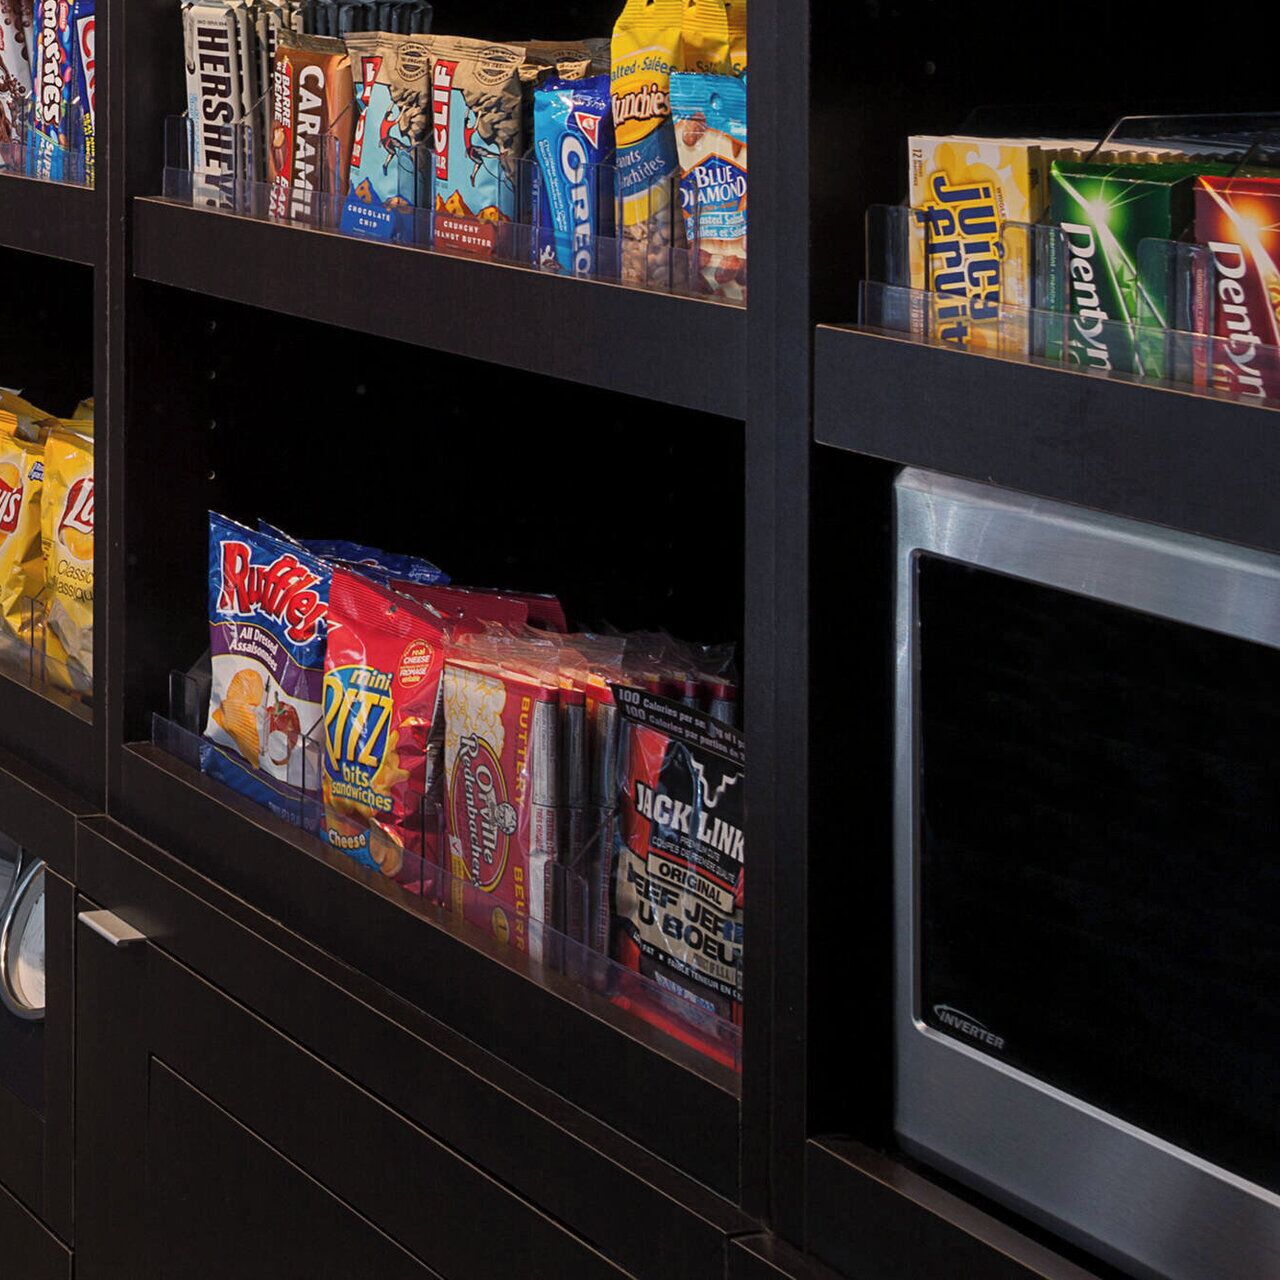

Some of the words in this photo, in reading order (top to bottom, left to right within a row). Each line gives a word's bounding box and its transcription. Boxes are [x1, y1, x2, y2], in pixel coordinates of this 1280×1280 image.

[274, 72, 283, 125] DEMIE
[281, 73, 291, 128] BARRE
[434, 64, 453, 154] CLIF
[695, 165, 734, 189] BLUE
[347, 204, 391, 222] CHOCOLATE
[359, 218, 378, 229] CHIP
[561, 135, 591, 274] OREO
[443, 220, 480, 234] CRUNCHY
[461, 235, 492, 248] BUTTER
[933, 175, 1005, 321] juicy
[915, 206, 970, 350] fruit
[1060, 222, 1113, 371] Dentyn
[1208, 241, 1267, 398] Dentyn
[217, 540, 342, 645] Ruffles
[239, 626, 254, 639] All
[253, 631, 279, 653] Dressed
[403, 654, 431, 665] CHEESE
[350, 669, 393, 691] mini
[322, 676, 393, 771] RITZ
[618, 688, 640, 705] 100
[643, 698, 678, 718] Calories
[625, 704, 646, 721] 100
[648, 714, 684, 734] Calories
[700, 735, 728, 753] portion
[515, 695, 532, 808] BUTTERY
[331, 779, 392, 812] sandwiches
[342, 762, 369, 788] bits
[475, 764, 498, 864] Orville
[635, 779, 693, 835] JACK
[328, 828, 366, 849] Cheese
[658, 862, 722, 906] ORIGINAL
[720, 983, 733, 996] EN
[940, 1009, 1005, 1050] INVERTER
